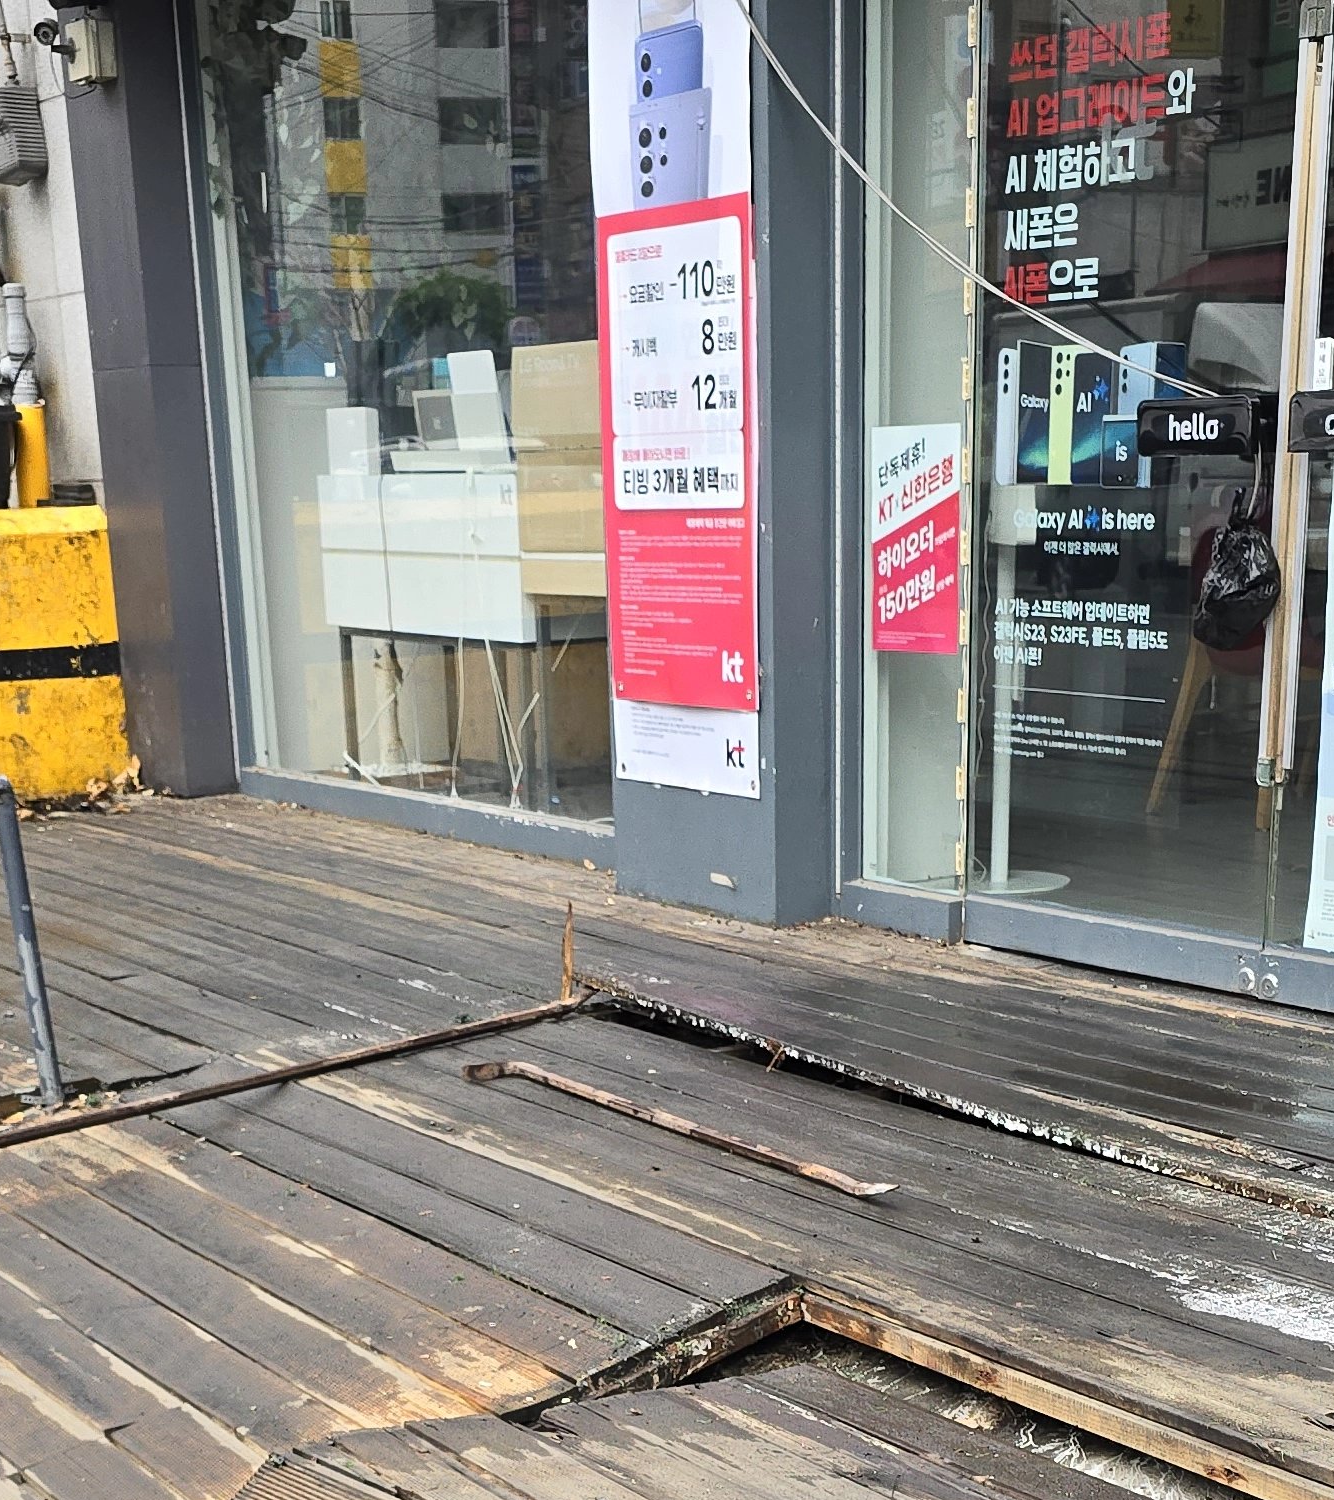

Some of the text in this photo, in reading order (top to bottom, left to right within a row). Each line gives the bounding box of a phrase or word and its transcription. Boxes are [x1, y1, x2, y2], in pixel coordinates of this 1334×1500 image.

[1008, 11, 1172, 82] 쓰던 갤럭시폰
[1006, 67, 1197, 138] AI 업그레이드와
[1005, 138, 1136, 194] AI 체험하고
[1003, 202, 1079, 251] 새폰은
[629, 281, 664, 303] 요금할인
[1020, 394, 1050, 414] Galaxy
[1076, 393, 1092, 413] AI
[1168, 412, 1219, 442] hello
[879, 437, 926, 488] 단독제휴!
[1115, 441, 1128, 462] is
[623, 468, 649, 495] 티빙
[652, 467, 689, 495] 3개월
[879, 454, 954, 524] KT 신한은행
[1014, 507, 1156, 535] Galaxy AI is here
[878, 520, 934, 578] 하이오더
[878, 564, 936, 624] 150만원
[995, 598, 1150, 625] AI 기능 소프트웨어 업데이트하면
[1050, 625, 1089, 648] S23FE,
[1092, 627, 1124, 650] 폴드5,
[1127, 629, 1169, 650] 플립5도
[721, 650, 745, 684] kt
[726, 738, 746, 769] kt
